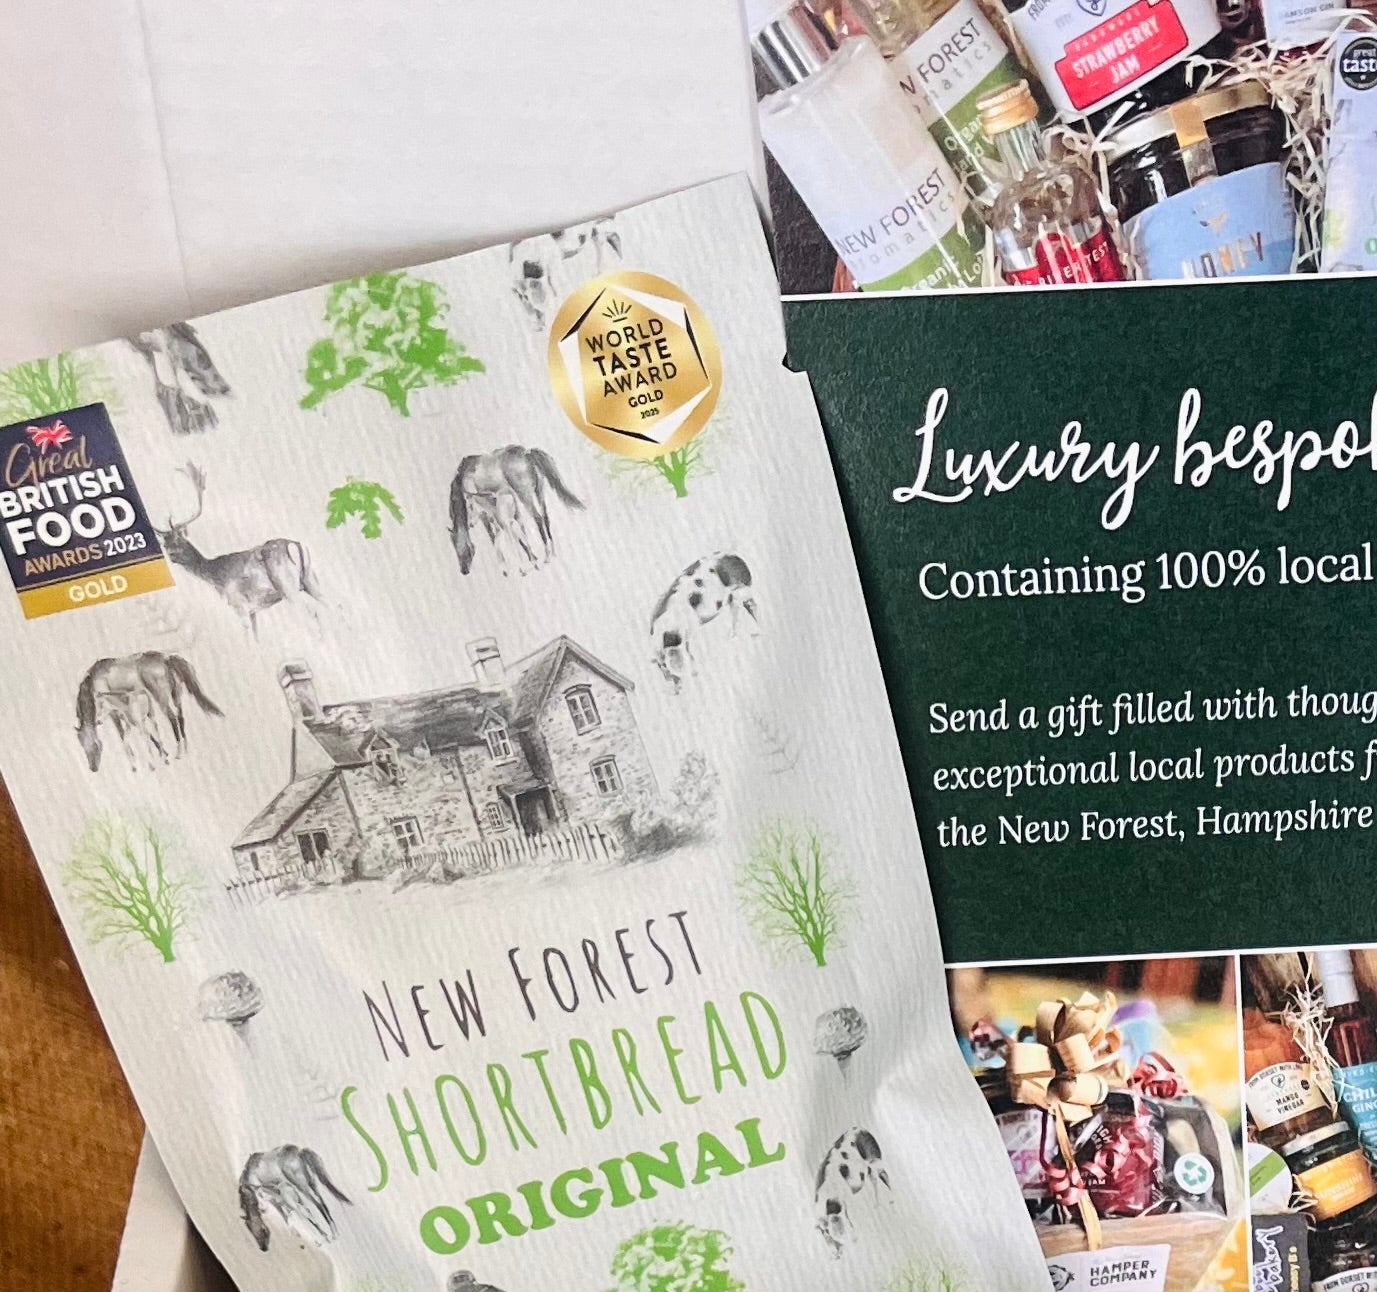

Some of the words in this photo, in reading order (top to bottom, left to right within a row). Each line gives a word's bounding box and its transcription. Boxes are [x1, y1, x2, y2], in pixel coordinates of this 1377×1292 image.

[917, 18, 982, 83] FOREST
[1071, 15, 1159, 78] STRAWBERRY
[1111, 54, 1141, 85] JAM
[834, 226, 877, 256] NEW
[880, 167, 946, 236] FOREST
[585, 318, 663, 353] WORLD
[593, 338, 671, 376] TASTE
[604, 362, 677, 397] AWARD
[628, 390, 663, 408] GOLD
[641, 408, 660, 419] 2025
[892, 387, 1160, 531] Luxury
[0, 465, 124, 519] BRITISH
[6, 496, 136, 555] FOOD
[25, 543, 103, 576] AWARDS
[104, 533, 146, 556] 2023
[919, 556, 1146, 604] Containing
[1155, 549, 1267, 591] 100%
[1277, 543, 1375, 585] local
[69, 575, 128, 602] GOLD
[929, 699, 1009, 734] Send
[1018, 703, 1039, 729] a
[1048, 695, 1104, 738] gift
[1108, 692, 1195, 735] filled
[1202, 687, 1276, 721] with
[933, 752, 1120, 797] exceptional
[1129, 748, 1205, 782] local
[1213, 742, 1355, 787] products
[936, 816, 988, 849] the
[998, 814, 1070, 846] New
[1080, 808, 1186, 843] Forest,
[1196, 799, 1373, 838] Hampshire
[363, 969, 488, 1062] NEW
[509, 911, 702, 1022] FOREST
[340, 990, 789, 1193] SHORTBREAD
[420, 1117, 786, 1255] ORIGINAL
[1090, 1261, 1149, 1277] HAMPER
[1090, 1270, 1157, 1287] COMPANY
